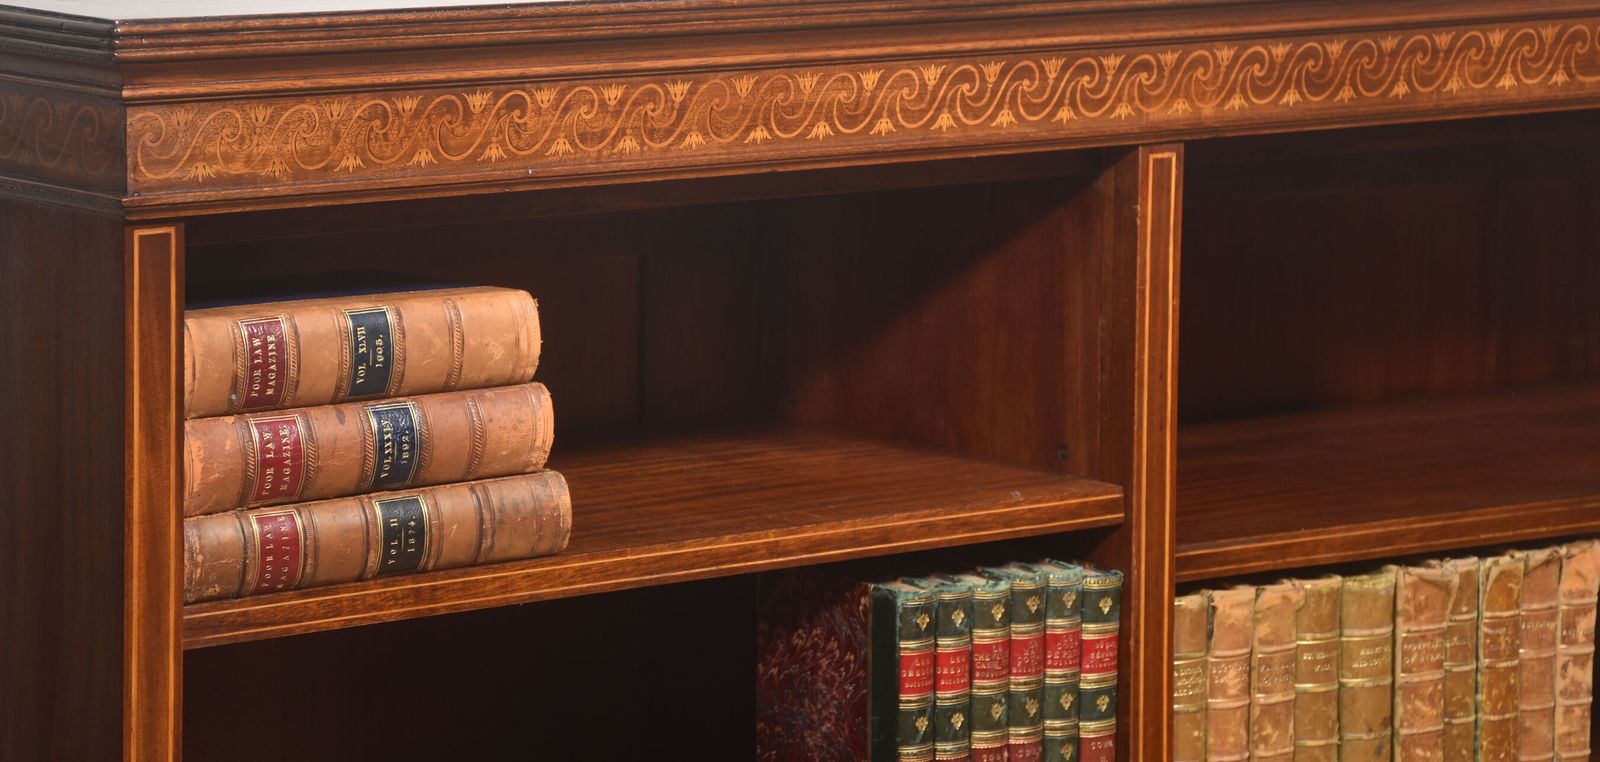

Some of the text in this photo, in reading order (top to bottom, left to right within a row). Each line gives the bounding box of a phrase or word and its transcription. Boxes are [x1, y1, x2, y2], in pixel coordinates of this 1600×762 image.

[250, 336, 263, 397] POOR LAW
[266, 333, 277, 396] MAGAZINE
[356, 326, 367, 385] VOL XLVII
[261, 431, 275, 496] POOR LAW
[262, 523, 274, 588] POOR LAW
[275, 515, 291, 589] MAGAZINE
